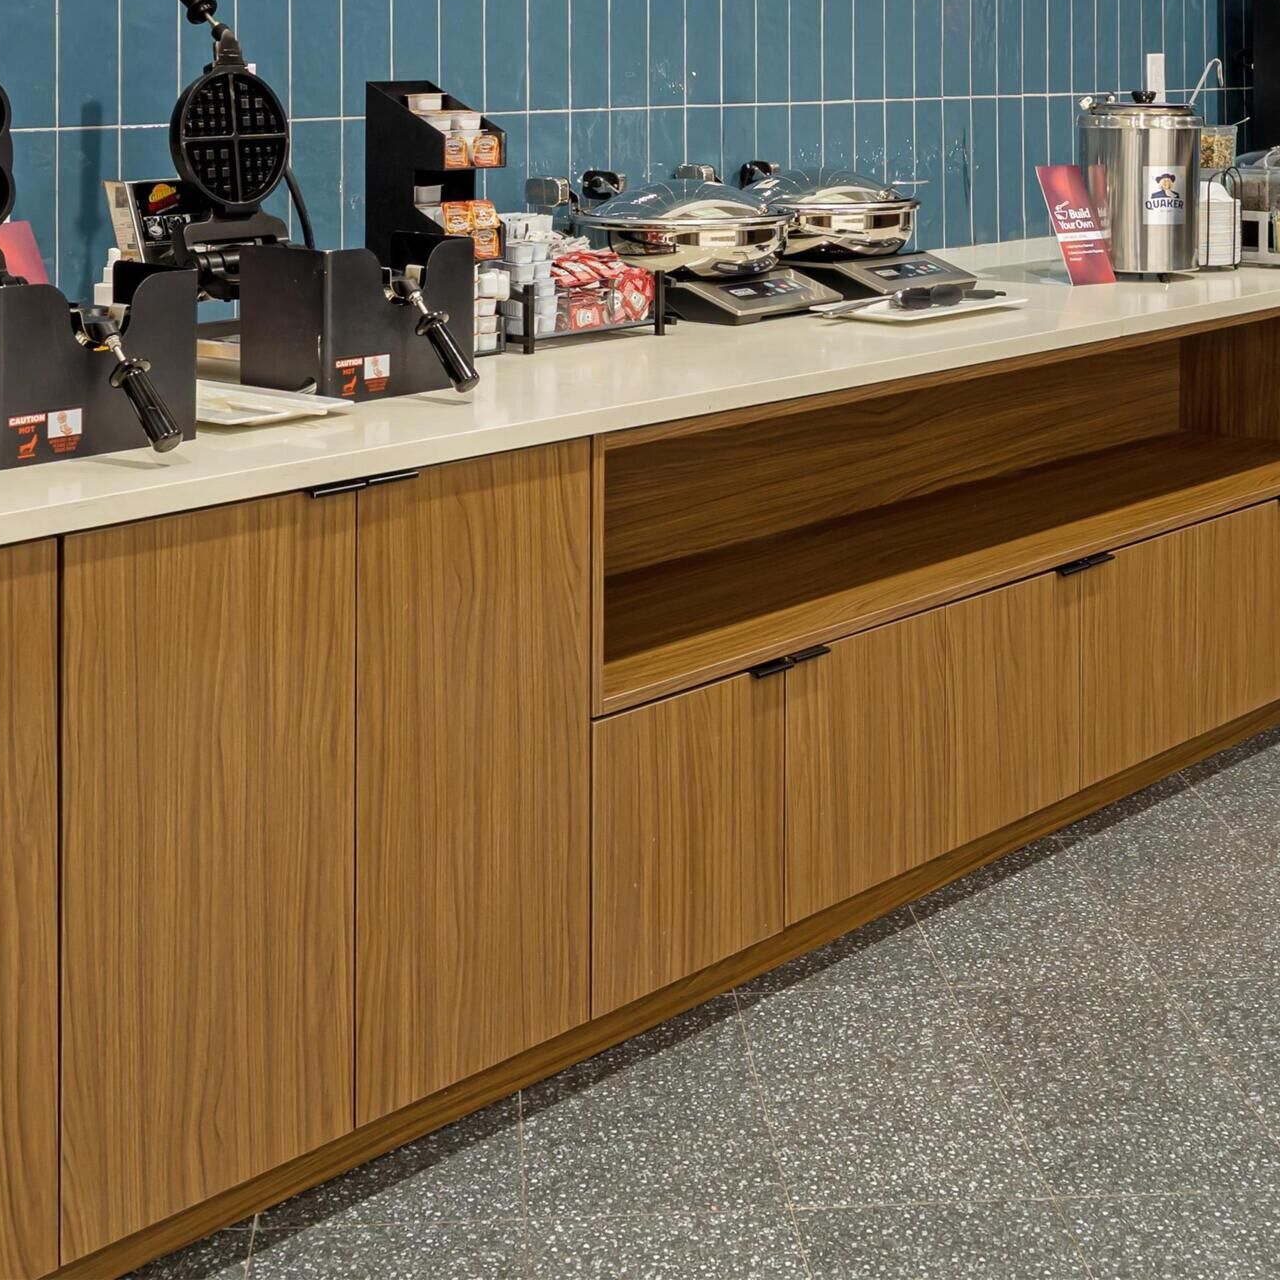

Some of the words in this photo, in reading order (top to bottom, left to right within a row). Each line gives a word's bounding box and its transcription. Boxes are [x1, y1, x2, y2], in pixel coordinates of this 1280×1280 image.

[1145, 199, 1184, 210] QUAKER
[1068, 207, 1092, 220] Build
[1058, 221, 1076, 230] Your
[1076, 219, 1095, 229] Own
[8, 414, 46, 426] CAUTION
[18, 425, 36, 435] HOT
